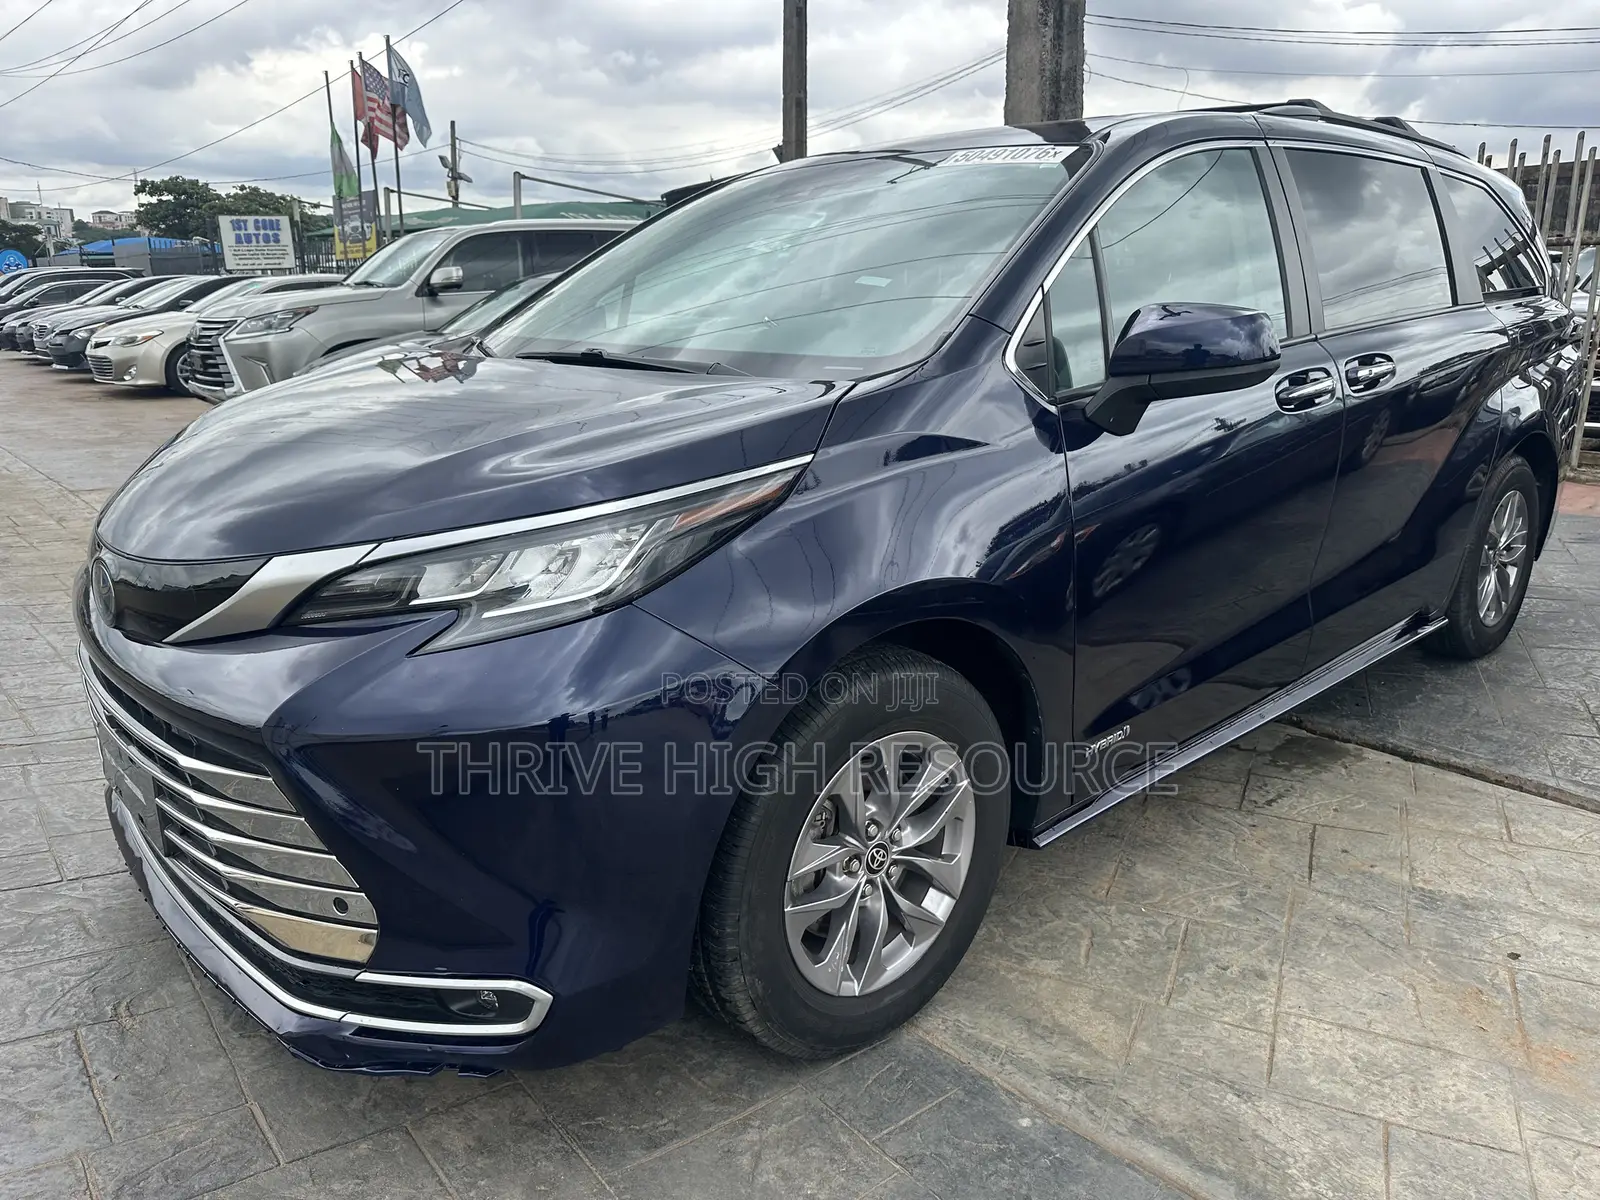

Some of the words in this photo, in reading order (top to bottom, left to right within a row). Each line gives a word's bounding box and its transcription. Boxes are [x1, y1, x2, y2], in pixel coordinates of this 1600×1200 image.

[229, 218, 248, 231] 1ST
[253, 218, 282, 231] CORE
[234, 232, 281, 244] AUTOS
[1085, 730, 1124, 758] HYBRID
